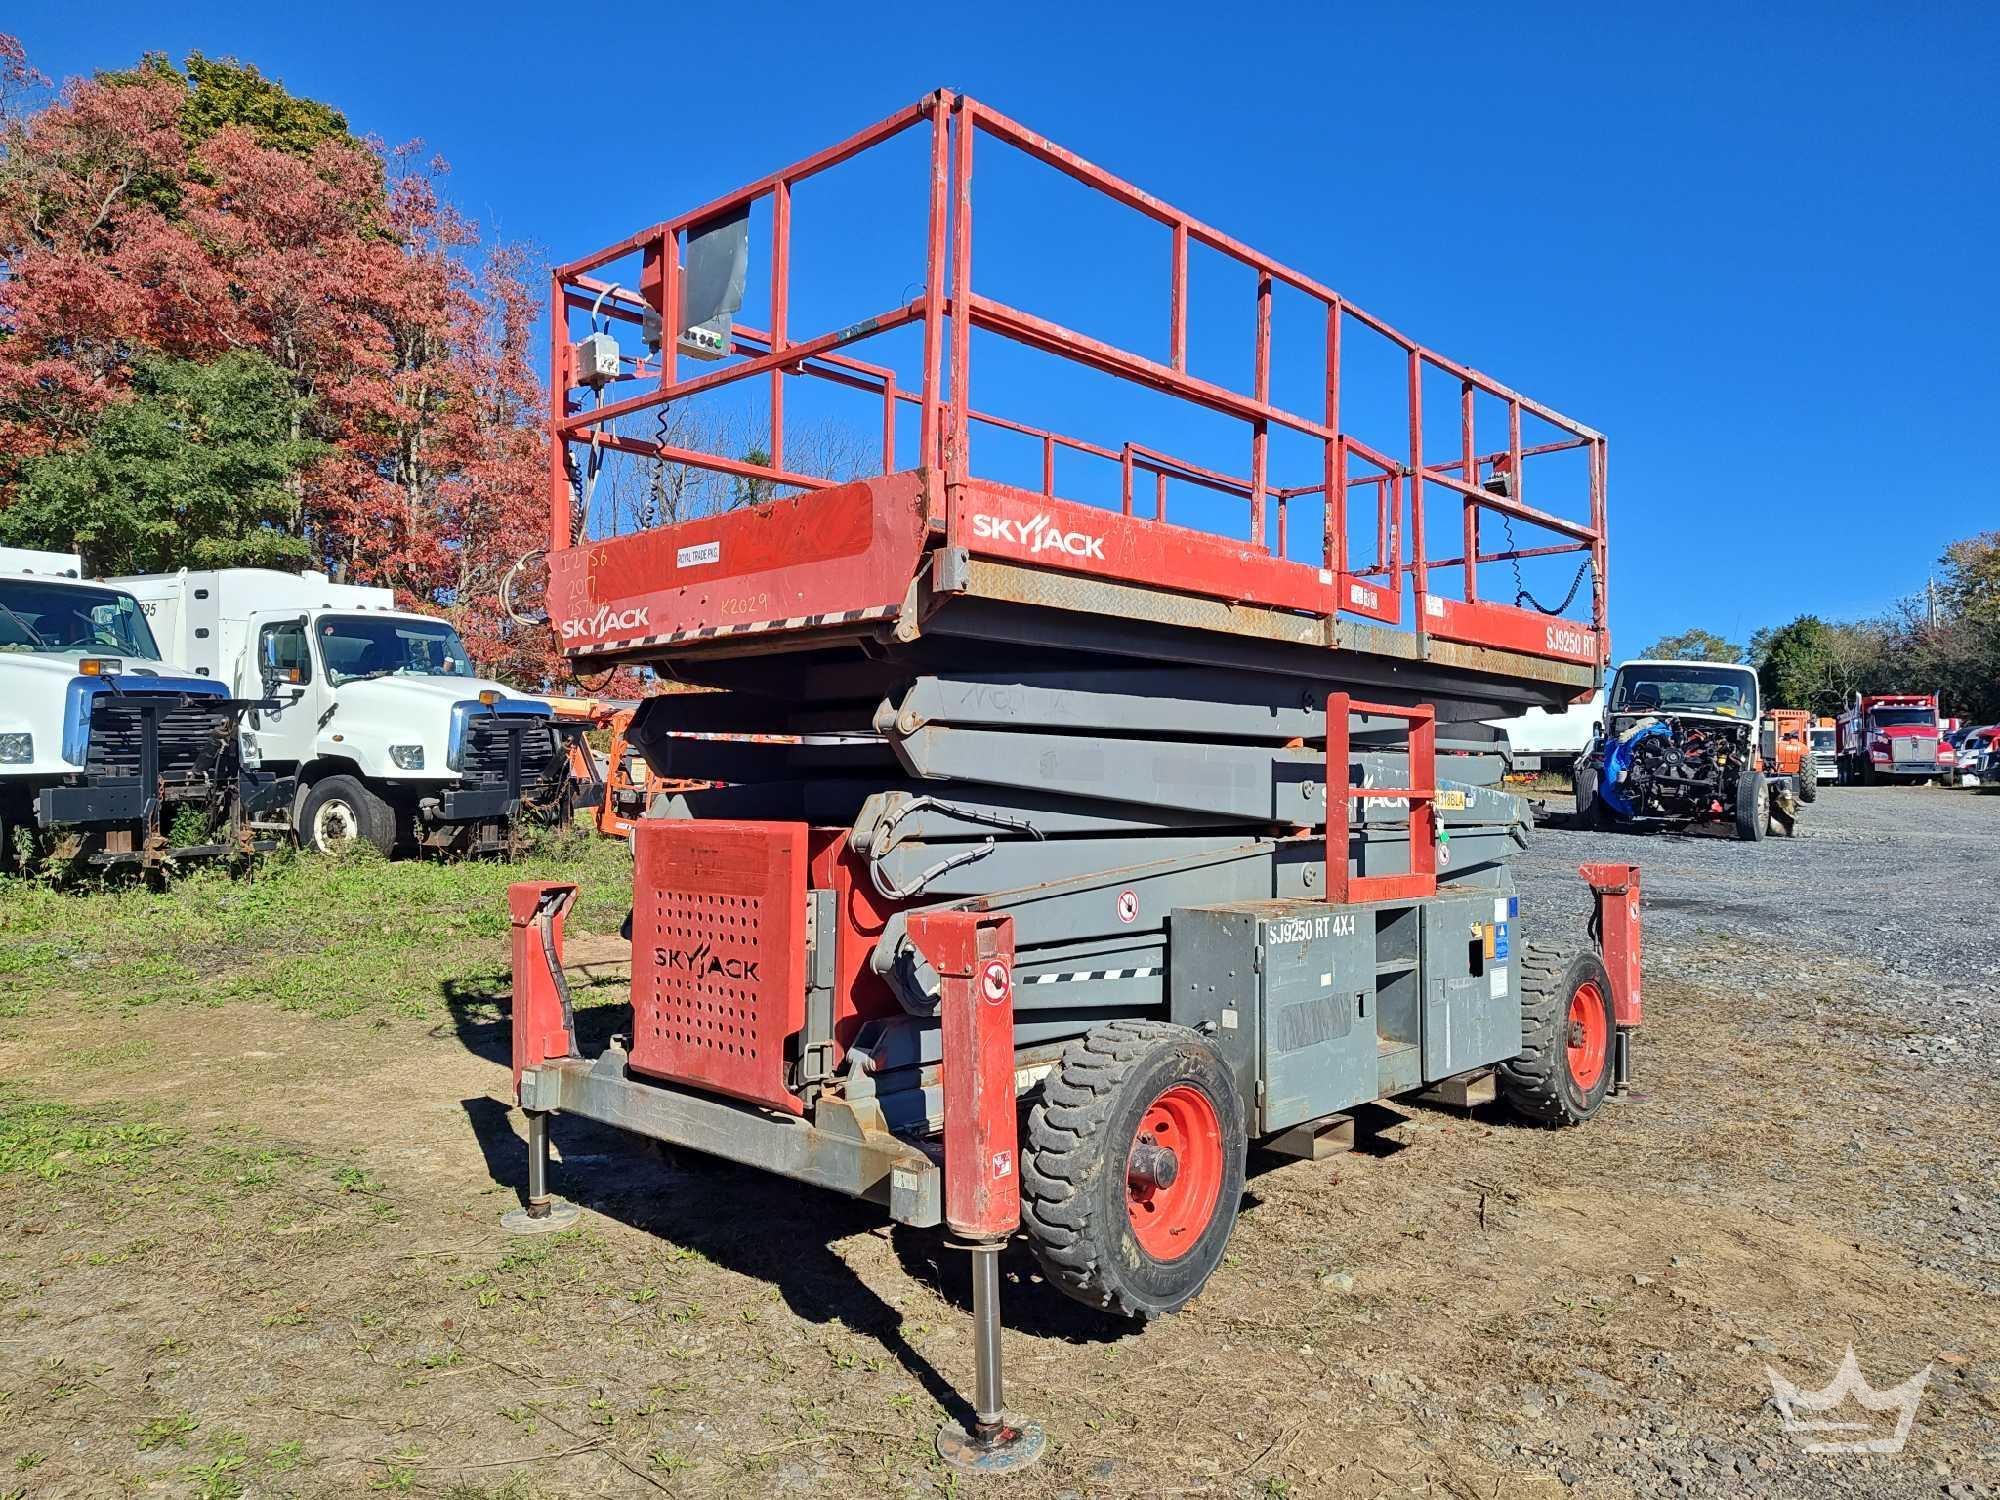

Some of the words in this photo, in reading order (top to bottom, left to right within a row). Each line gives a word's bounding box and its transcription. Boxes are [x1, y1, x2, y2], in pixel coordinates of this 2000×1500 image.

[973, 512, 1105, 560] SKYJACK
[562, 606, 650, 639] SKYJACK
[1546, 626, 1581, 655] SJ9250
[1583, 634, 1596, 657] RT
[1269, 919, 1313, 945] SJ9250
[1315, 917, 1330, 939] RT
[654, 942, 760, 982] SKYJACK
